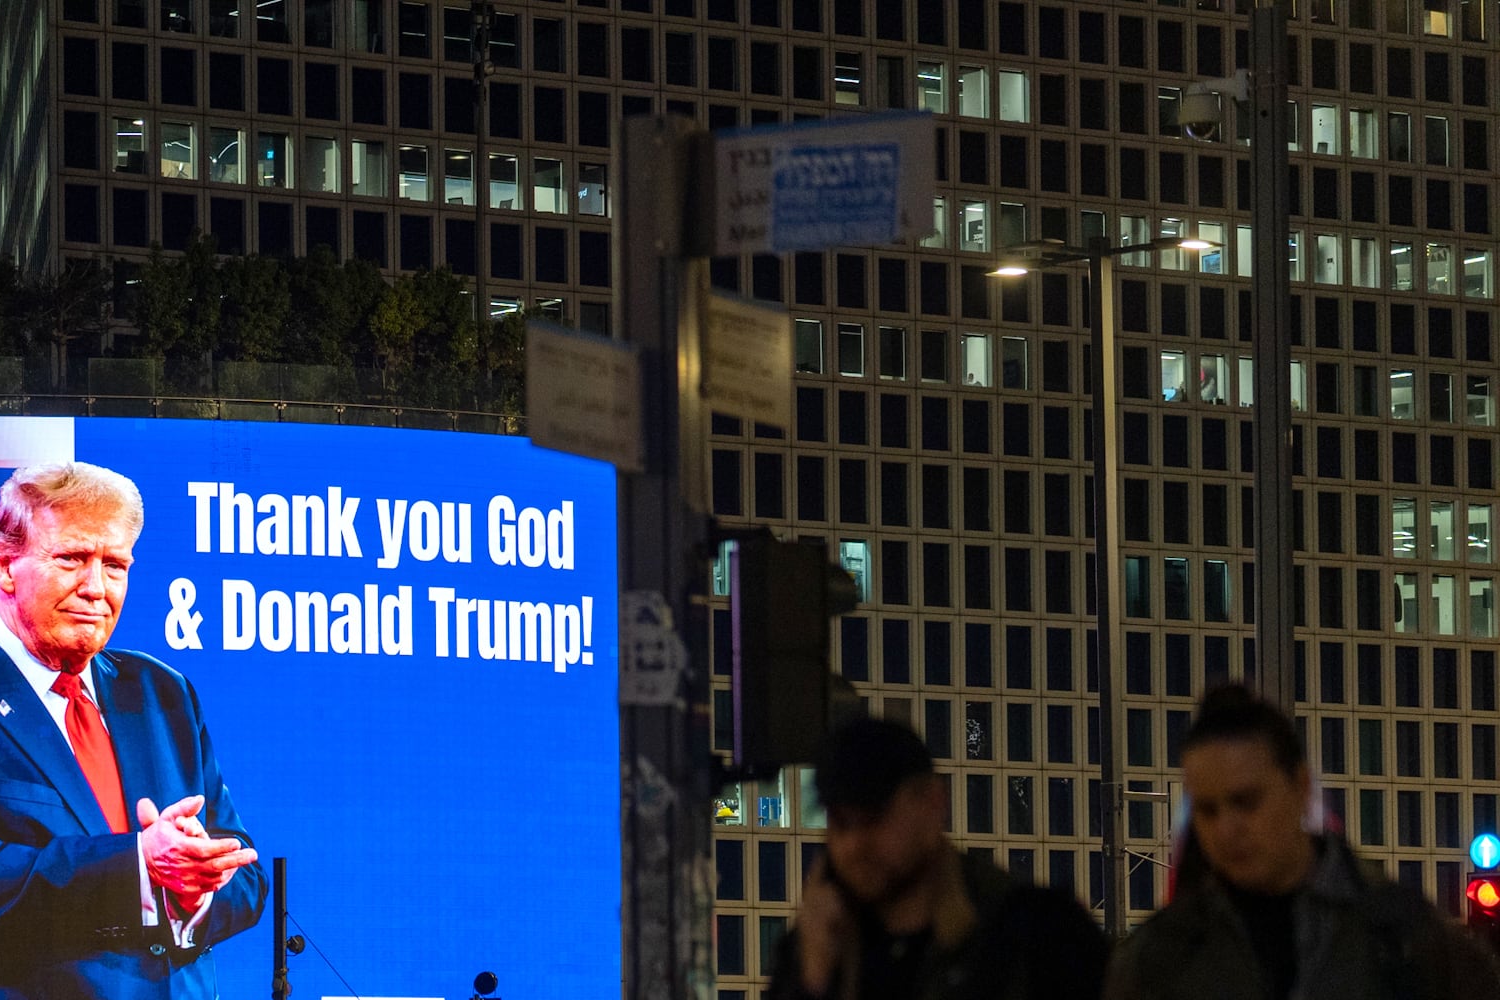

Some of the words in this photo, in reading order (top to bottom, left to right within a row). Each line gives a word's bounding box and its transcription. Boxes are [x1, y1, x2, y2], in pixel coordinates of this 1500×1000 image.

[188, 482, 363, 557] Thank
[376, 498, 472, 569] you
[488, 495, 575, 570] God
[165, 578, 204, 650] &
[223, 579, 413, 656] Donald
[428, 586, 594, 673] Trump!
